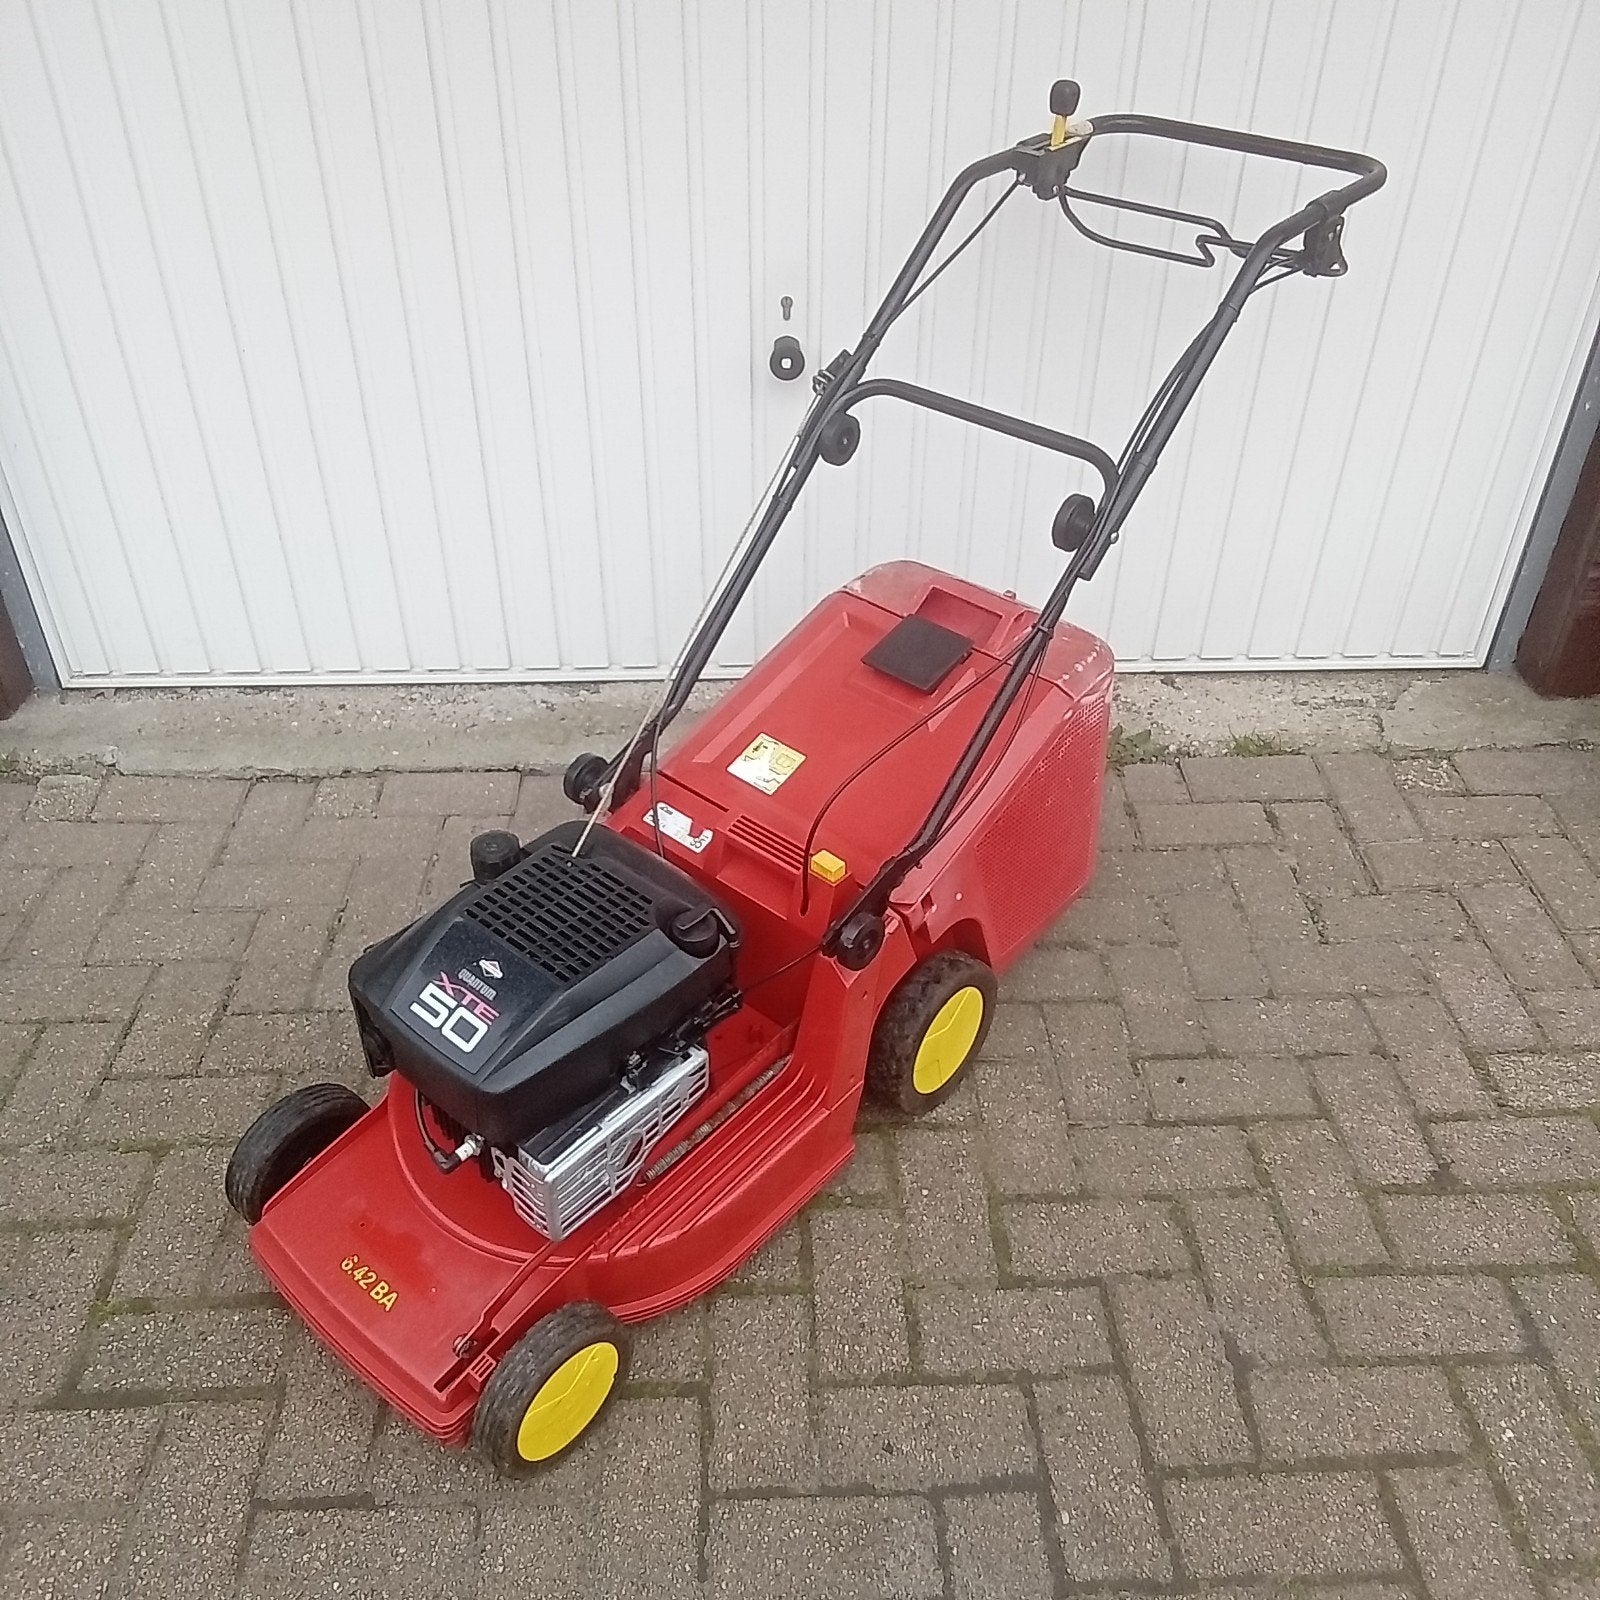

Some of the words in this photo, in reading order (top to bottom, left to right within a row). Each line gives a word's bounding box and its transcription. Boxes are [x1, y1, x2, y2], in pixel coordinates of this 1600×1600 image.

[433, 971, 500, 1025] XTE
[458, 968, 497, 1000] QUANTUM
[409, 982, 489, 1053] 50
[341, 1255, 377, 1290] 6.42
[369, 1280, 398, 1312] BA
